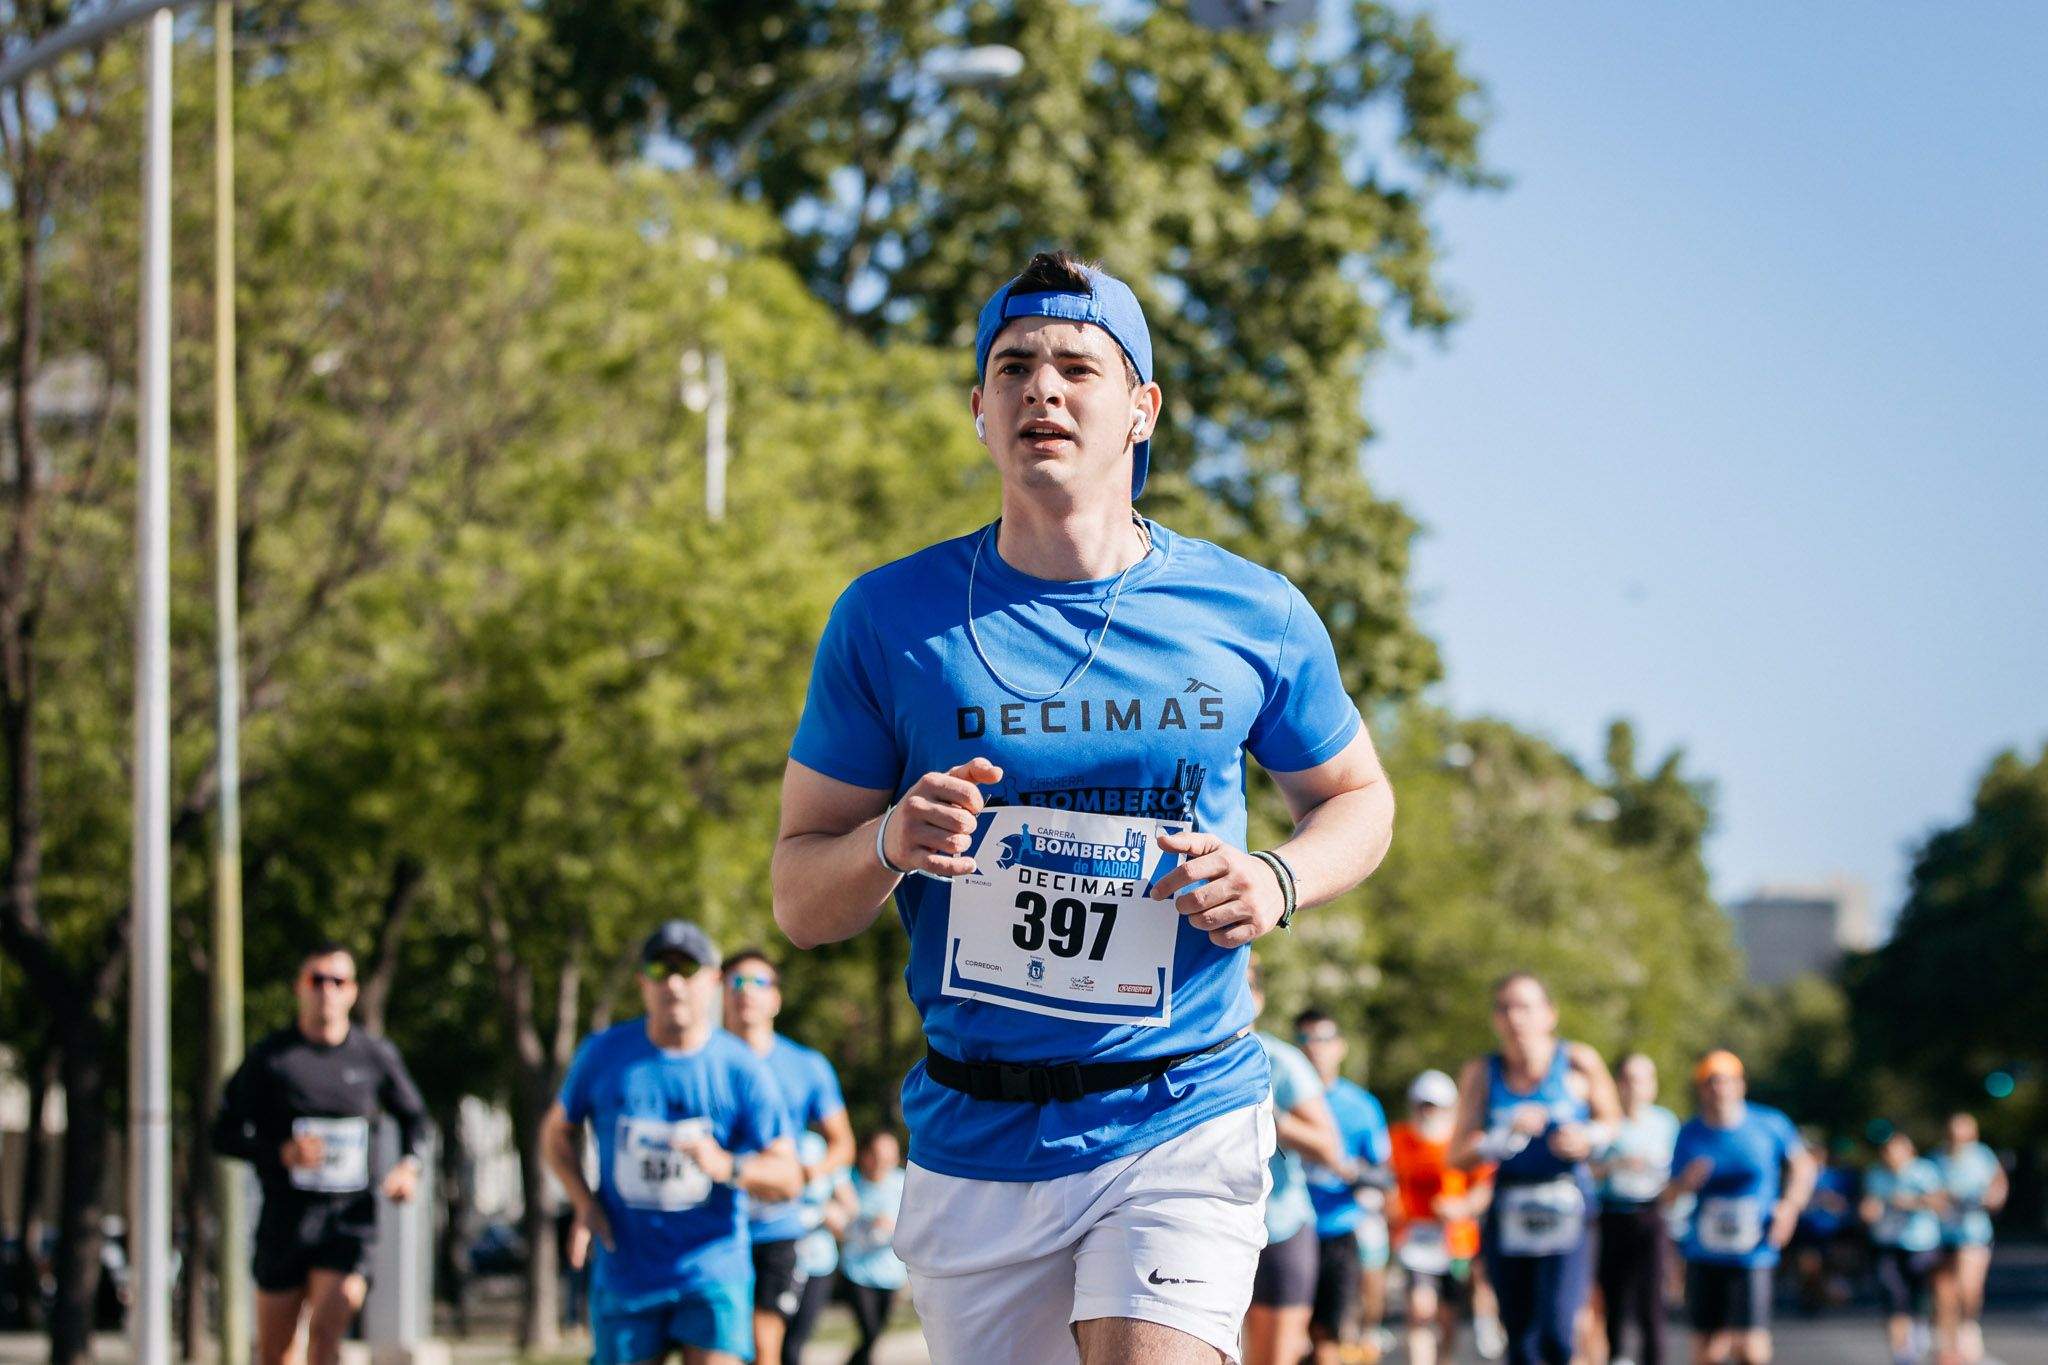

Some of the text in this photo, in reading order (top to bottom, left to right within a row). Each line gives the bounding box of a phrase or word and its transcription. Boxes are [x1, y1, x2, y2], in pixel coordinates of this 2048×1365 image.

[957, 697, 1224, 740] DECIMAS
[1027, 790, 1195, 813] BOMBEROS
[1037, 826, 1076, 840] CARRERA
[1034, 837, 1141, 862] BOMBEROS
[1073, 860, 1140, 879] de MADRID
[1018, 867, 1134, 898] DECIMAS
[1011, 890, 1118, 961] 397
